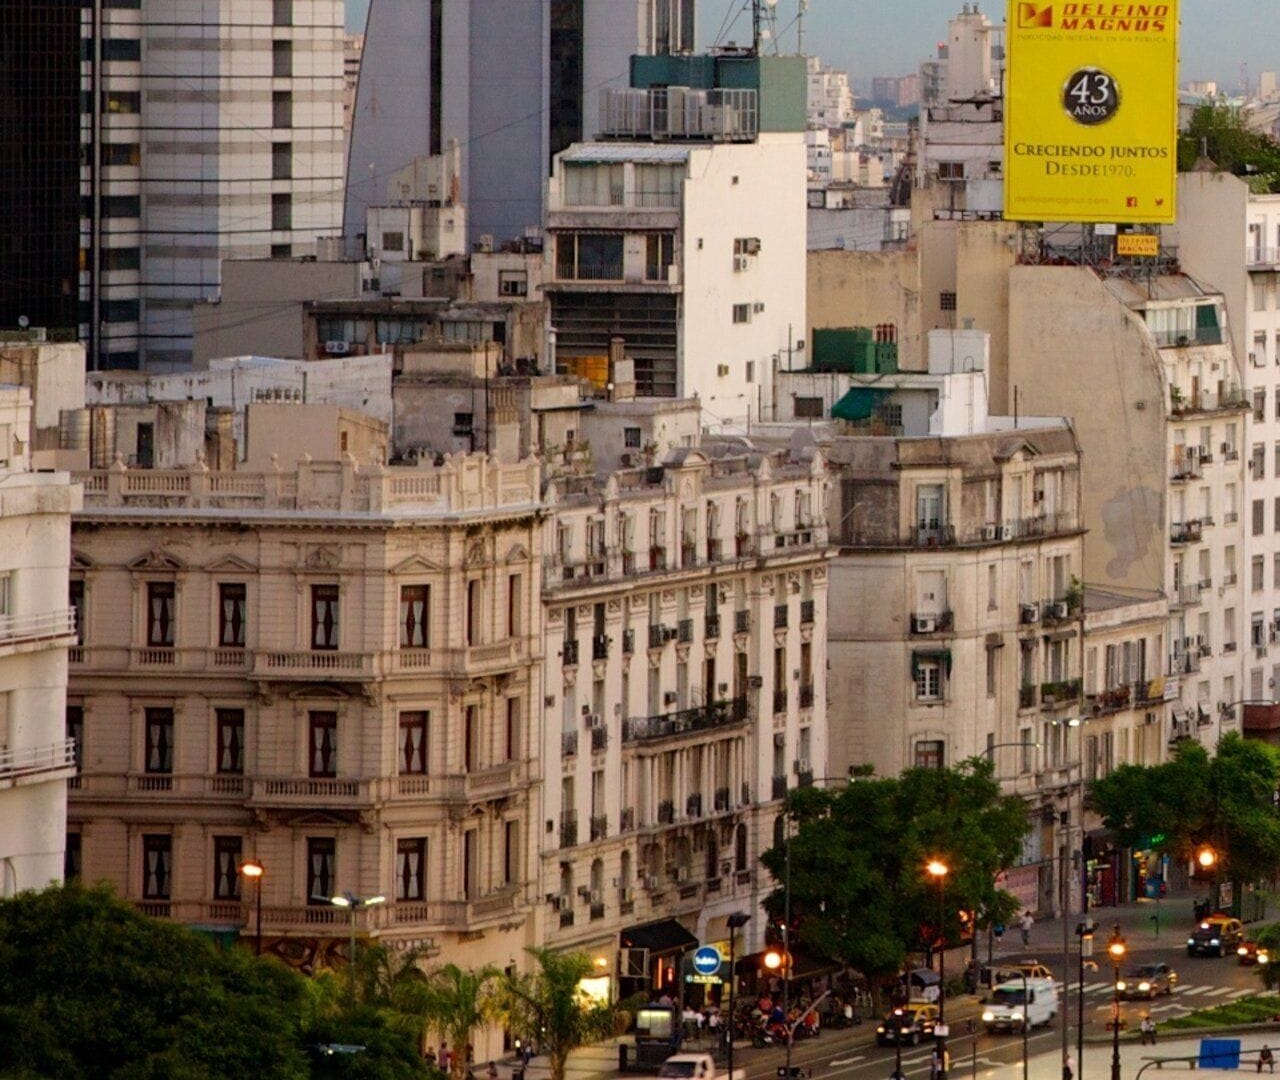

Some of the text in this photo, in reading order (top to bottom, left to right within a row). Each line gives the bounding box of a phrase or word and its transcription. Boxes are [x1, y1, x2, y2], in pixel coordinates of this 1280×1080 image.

[1062, 3, 1169, 17] DELFINO
[1060, 18, 1166, 32] MAGNUS
[1070, 75, 1109, 104] 43
[1074, 104, 1107, 116] AÑOS
[1014, 143, 1168, 159] CRECIENDO JUNTOS
[1046, 161, 1099, 176] DESDE
